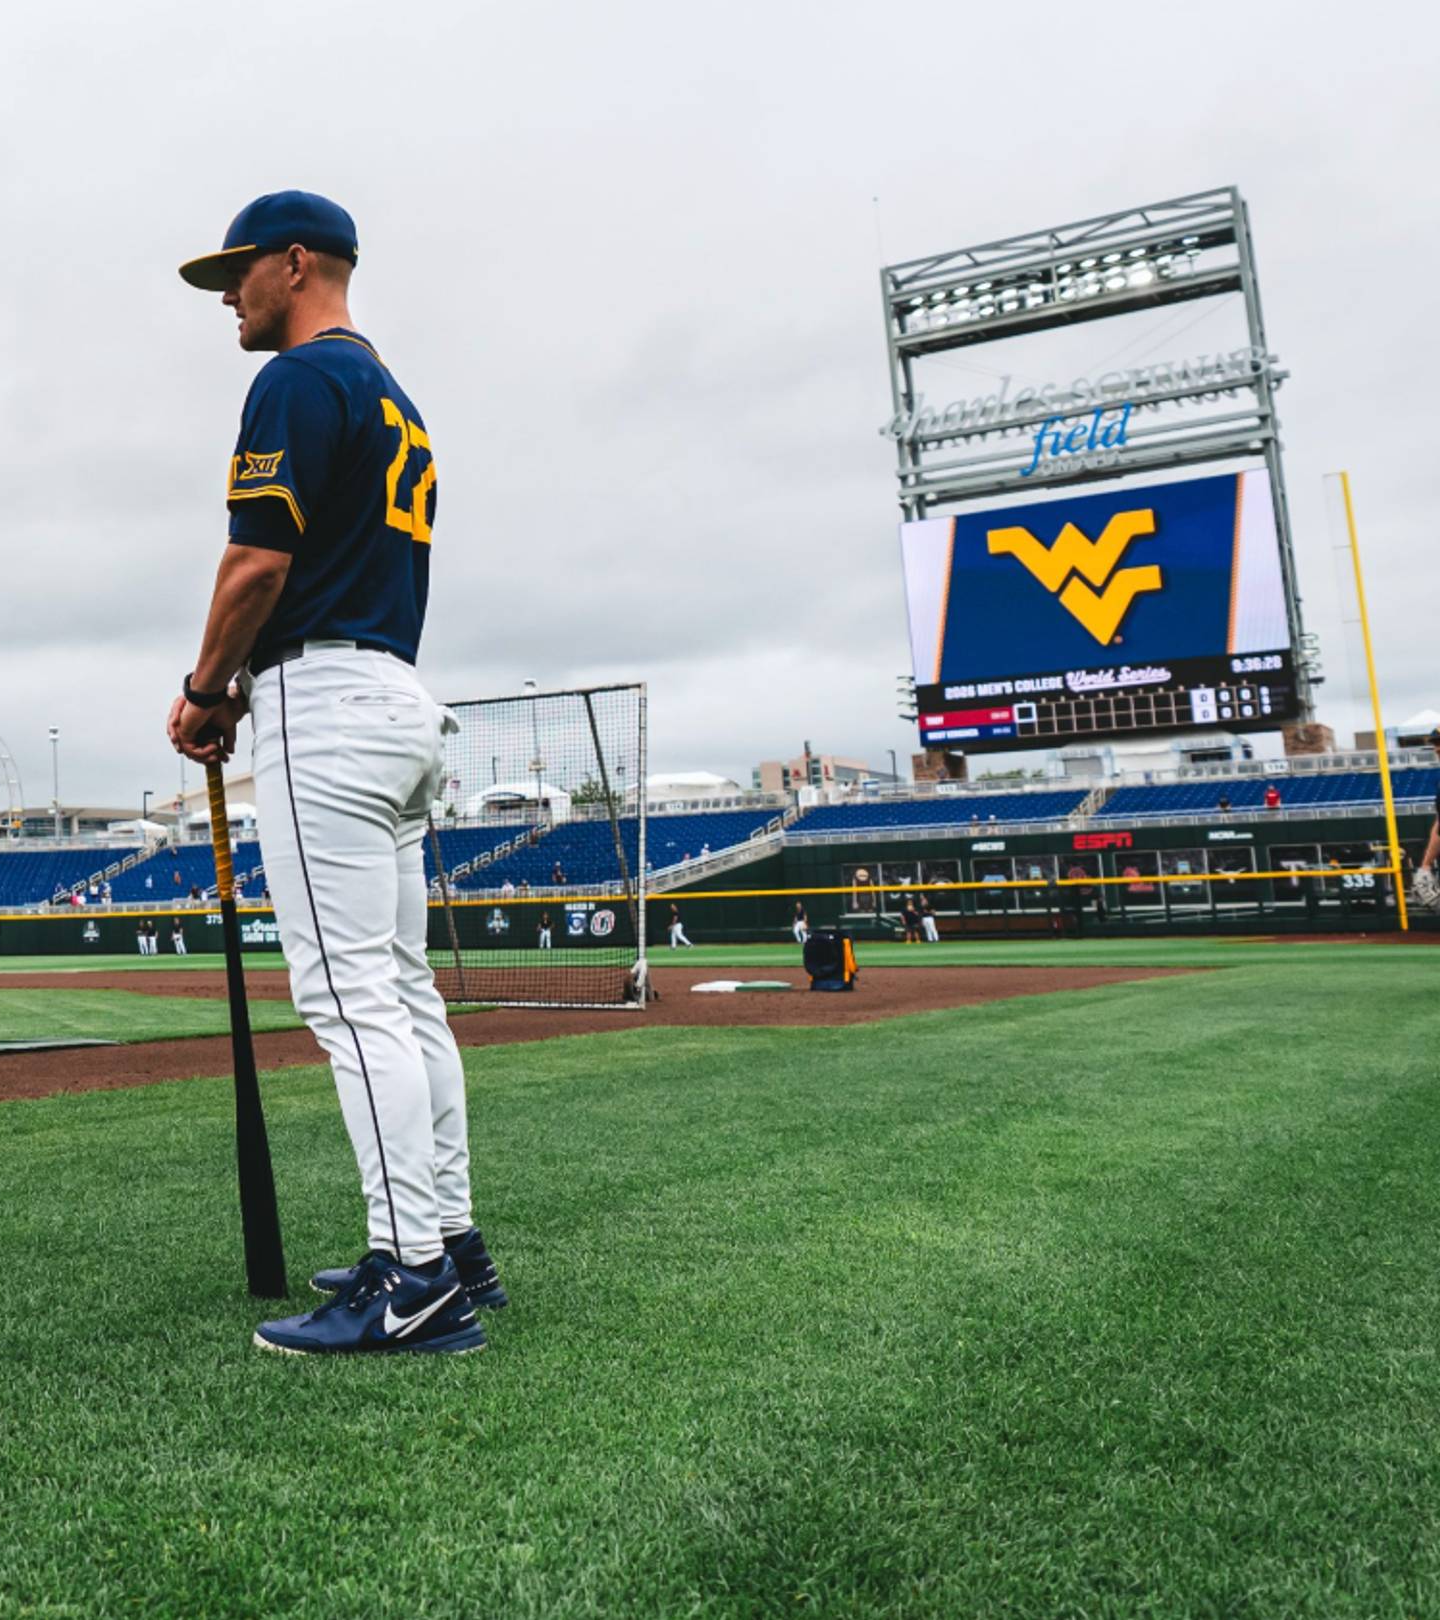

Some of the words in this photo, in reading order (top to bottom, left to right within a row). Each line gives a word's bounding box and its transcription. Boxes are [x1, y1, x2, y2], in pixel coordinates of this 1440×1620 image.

[1020, 402, 1134, 476] field
[1014, 676, 1063, 693] COLLEGE
[1073, 831, 1133, 850] ESPN
[1343, 874, 1375, 888] 335
